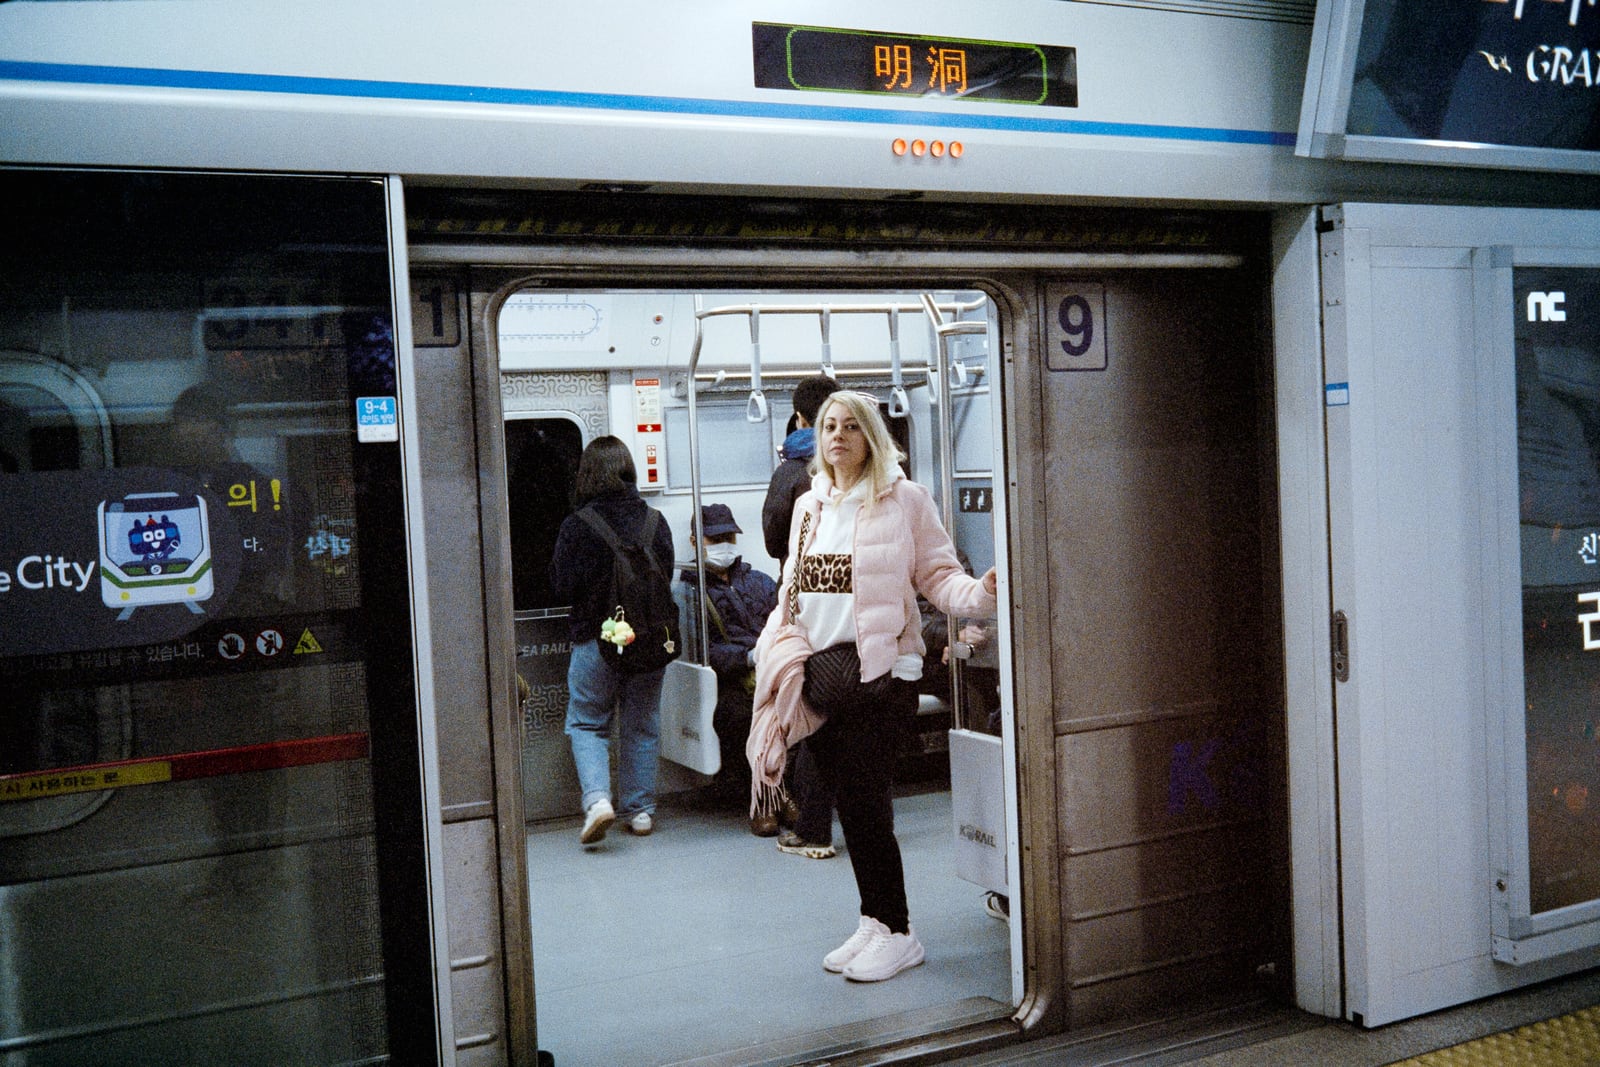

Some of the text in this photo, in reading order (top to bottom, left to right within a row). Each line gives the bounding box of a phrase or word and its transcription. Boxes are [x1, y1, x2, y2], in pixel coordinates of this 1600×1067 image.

[874, 44, 968, 94] 明洞
[1526, 44, 1600, 87] GRA
[1058, 294, 1094, 356] 9
[364, 400, 388, 414] 9-4
[1578, 532, 1600, 564] 신
[17, 554, 96, 593] City
[145, 642, 206, 662] 있습니다.
